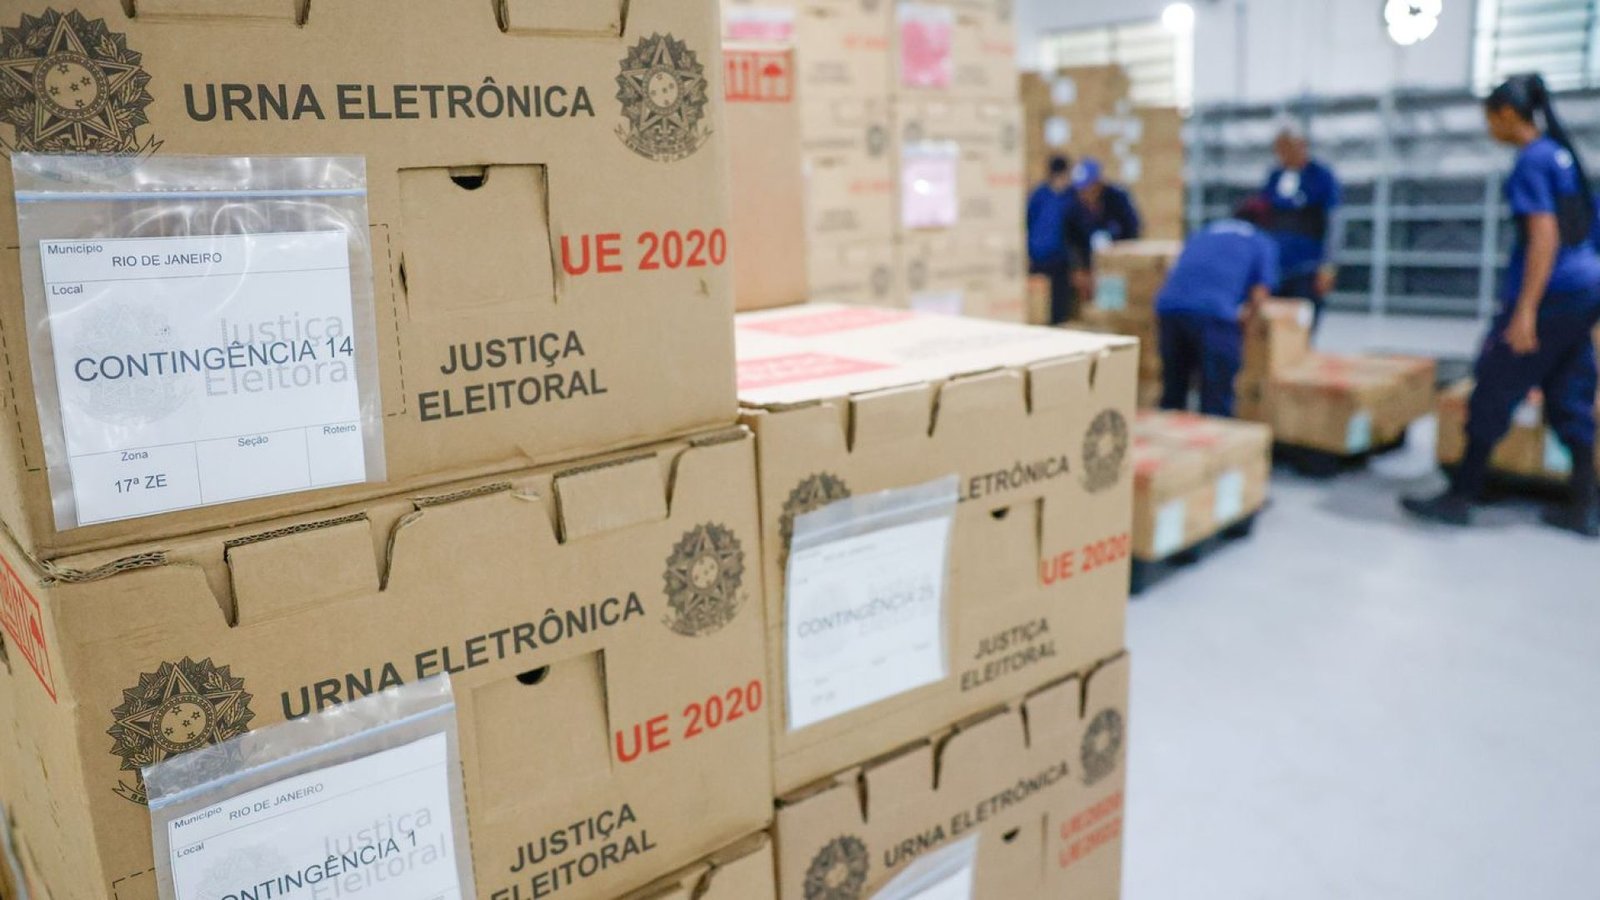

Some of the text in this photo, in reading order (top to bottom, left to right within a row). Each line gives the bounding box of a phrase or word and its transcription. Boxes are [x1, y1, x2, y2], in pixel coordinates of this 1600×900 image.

[184, 76, 595, 121] URNA ELETRÔNICA
[112, 252, 222, 267] RIO DE JANEIRO
[560, 228, 727, 276] UE 2020
[52, 284, 83, 295] Local
[75, 336, 353, 382] CONTINGÊNCIA 14
[440, 330, 585, 375] JUSTIÇA
[418, 368, 607, 422] ELEITORAL
[237, 435, 268, 448] Seção
[323, 423, 356, 436] Roteiro
[121, 449, 148, 461] Zona
[114, 474, 167, 493] 17ª ZE
[1041, 550, 1074, 586] UE
[281, 662, 404, 721] URNA
[415, 591, 645, 680] ELETRÔNICA
[974, 617, 1050, 660] JUSTIÇA
[960, 641, 1057, 692] ELEITORAL
[615, 679, 763, 764] UE 2020
[174, 783, 324, 830] Município RIO DE JANEIRO
[884, 761, 1070, 869] URNA ELETRÔNICA
[177, 842, 205, 858] Local
[408, 830, 416, 847] 1
[510, 803, 636, 873] JUSTIÇA
